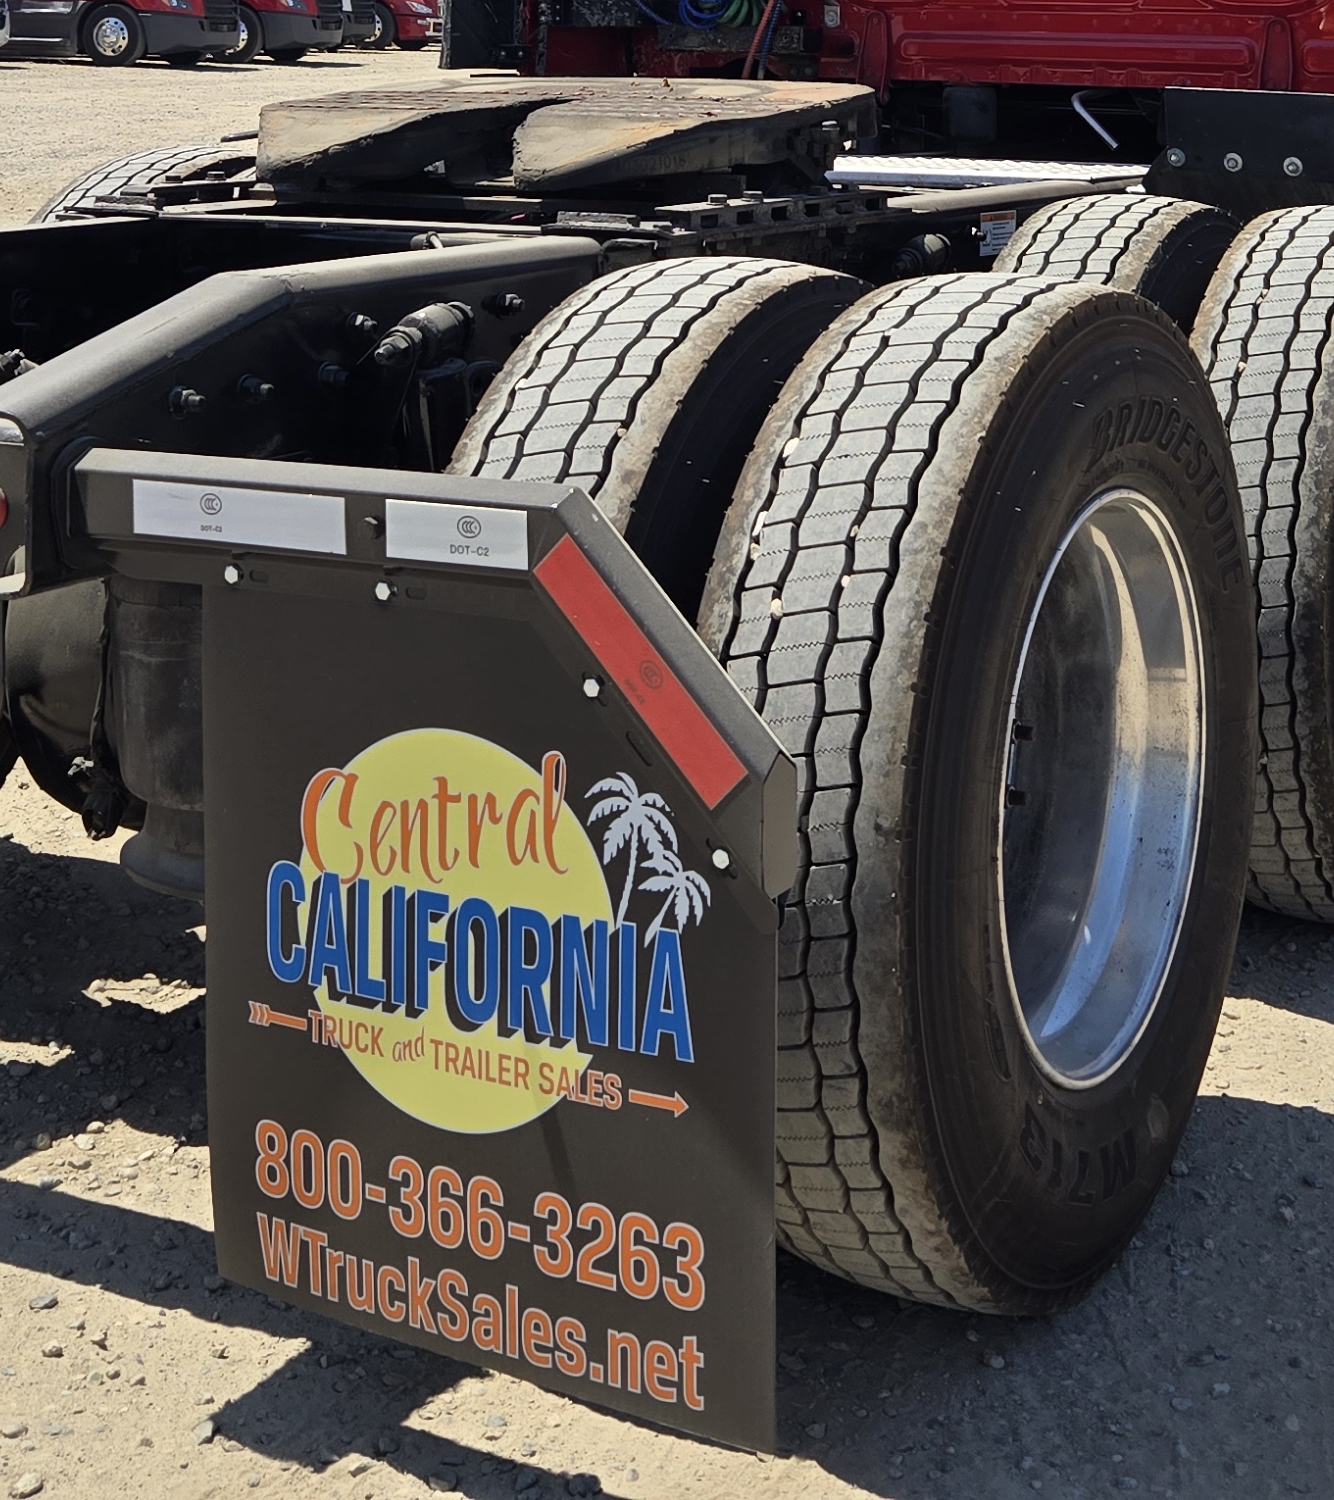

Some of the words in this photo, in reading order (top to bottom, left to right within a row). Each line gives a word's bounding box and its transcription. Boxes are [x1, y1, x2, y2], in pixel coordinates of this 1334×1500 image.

[200, 524, 223, 533] DOT-C2
[449, 543, 490, 557] DOT-C2
[1083, 395, 1246, 594] BRIDGESTONE
[300, 751, 569, 885] Central
[267, 860, 696, 1063] CALIFORNIA
[307, 1009, 384, 1058] TRUCK
[392, 1025, 425, 1063] and
[429, 1038, 530, 1090] TRAILER
[538, 1062, 623, 1110] SALES
[254, 1119, 706, 1312] 800-366-3263
[1019, 1100, 1137, 1205] M713
[256, 1211, 706, 1412] WTruckSales.net
